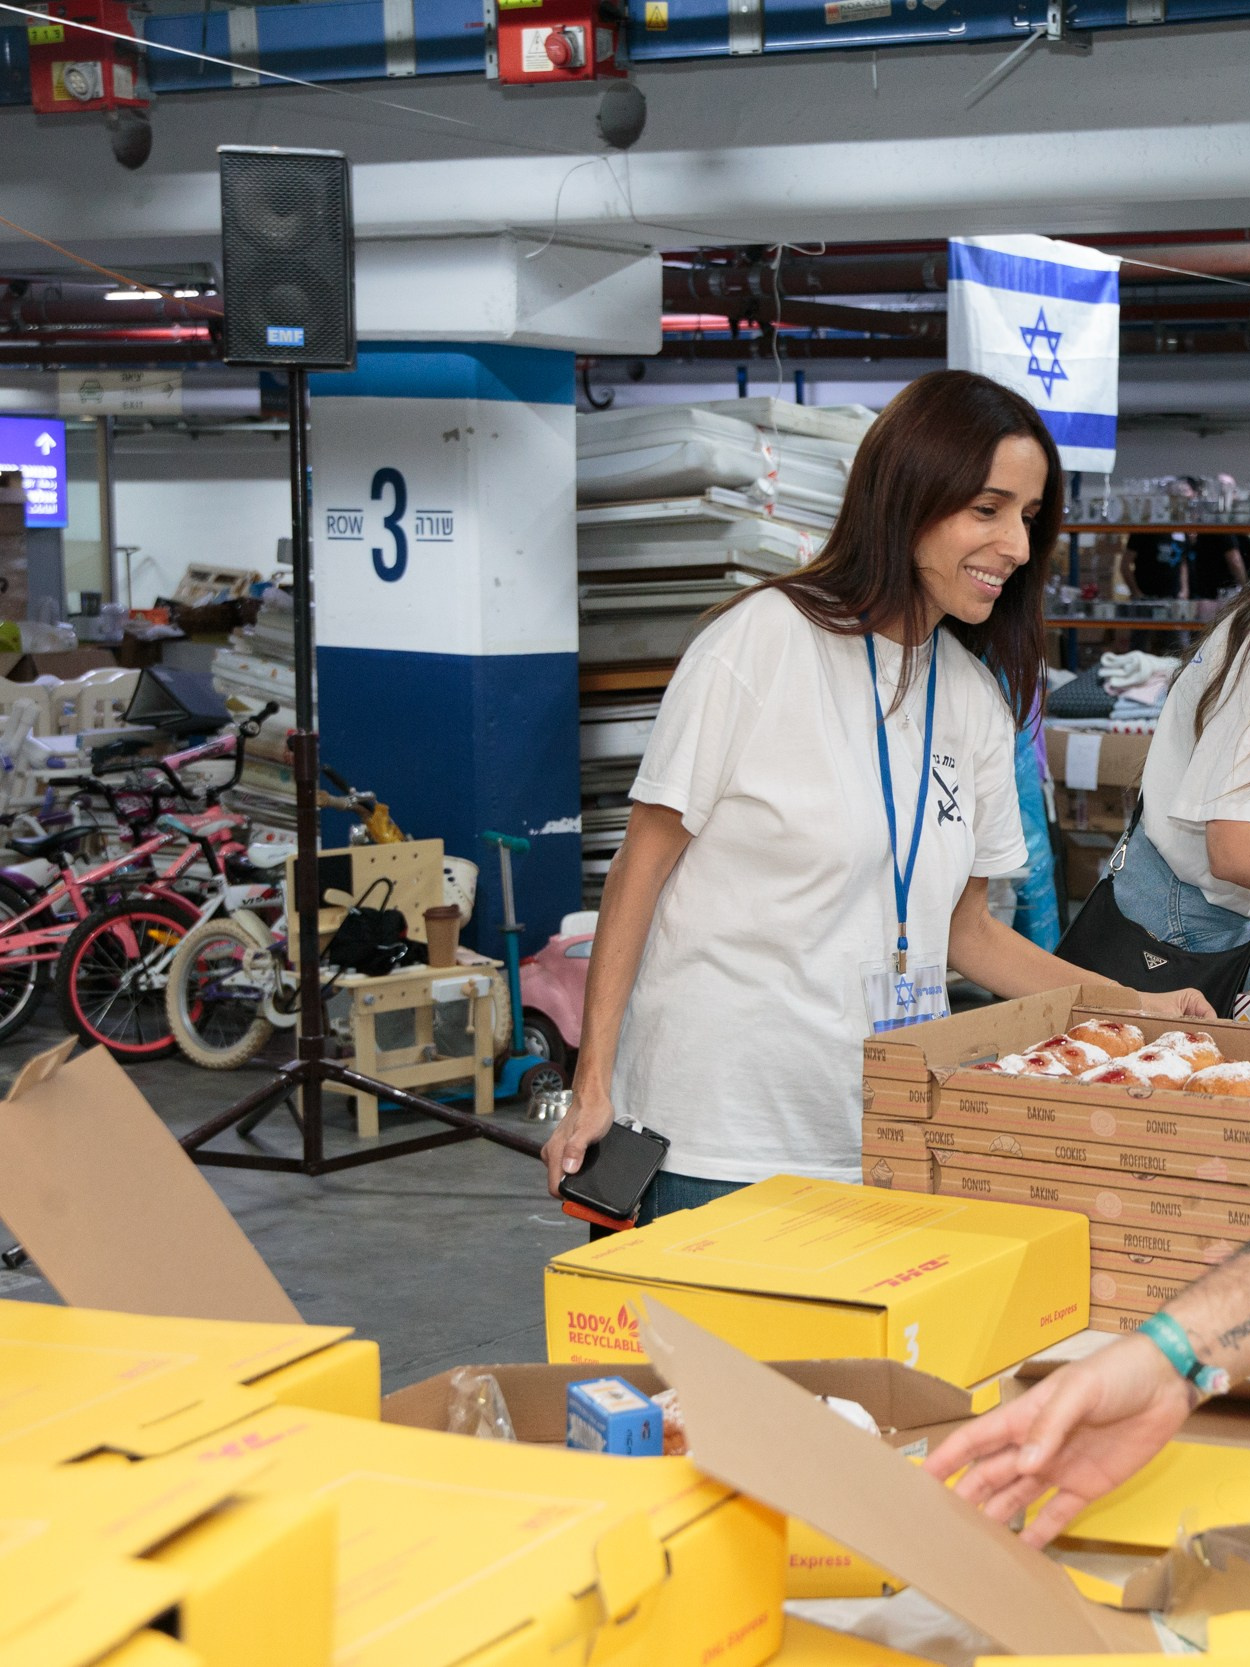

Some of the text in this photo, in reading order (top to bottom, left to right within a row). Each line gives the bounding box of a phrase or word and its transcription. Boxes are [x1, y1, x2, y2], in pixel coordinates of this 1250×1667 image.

[267, 329, 303, 342] EMF
[327, 467, 408, 582] ROW 3
[416, 516, 454, 536] שורה
[960, 1099, 988, 1114] DONUTS
[1027, 1106, 1055, 1122] BAKING
[1146, 1120, 1177, 1135] DONUTS
[877, 1127, 904, 1142] BAKING
[924, 1130, 954, 1146] COOKIES
[1055, 1146, 1087, 1161] COOKIES
[1120, 1153, 1166, 1171] PROFITEROLE
[962, 1177, 991, 1193] DONUTS
[1030, 1185, 1058, 1201] BAKING
[1150, 1201, 1182, 1217] DONUTS
[1124, 1234, 1171, 1252] PROFITEROLE
[1146, 1284, 1177, 1299] DONUTS
[567, 1311, 615, 1334] 100%
[1040, 1303, 1077, 1327] DHL Express
[569, 1331, 644, 1353] RECYCLABLE
[790, 1554, 852, 1569] Express
